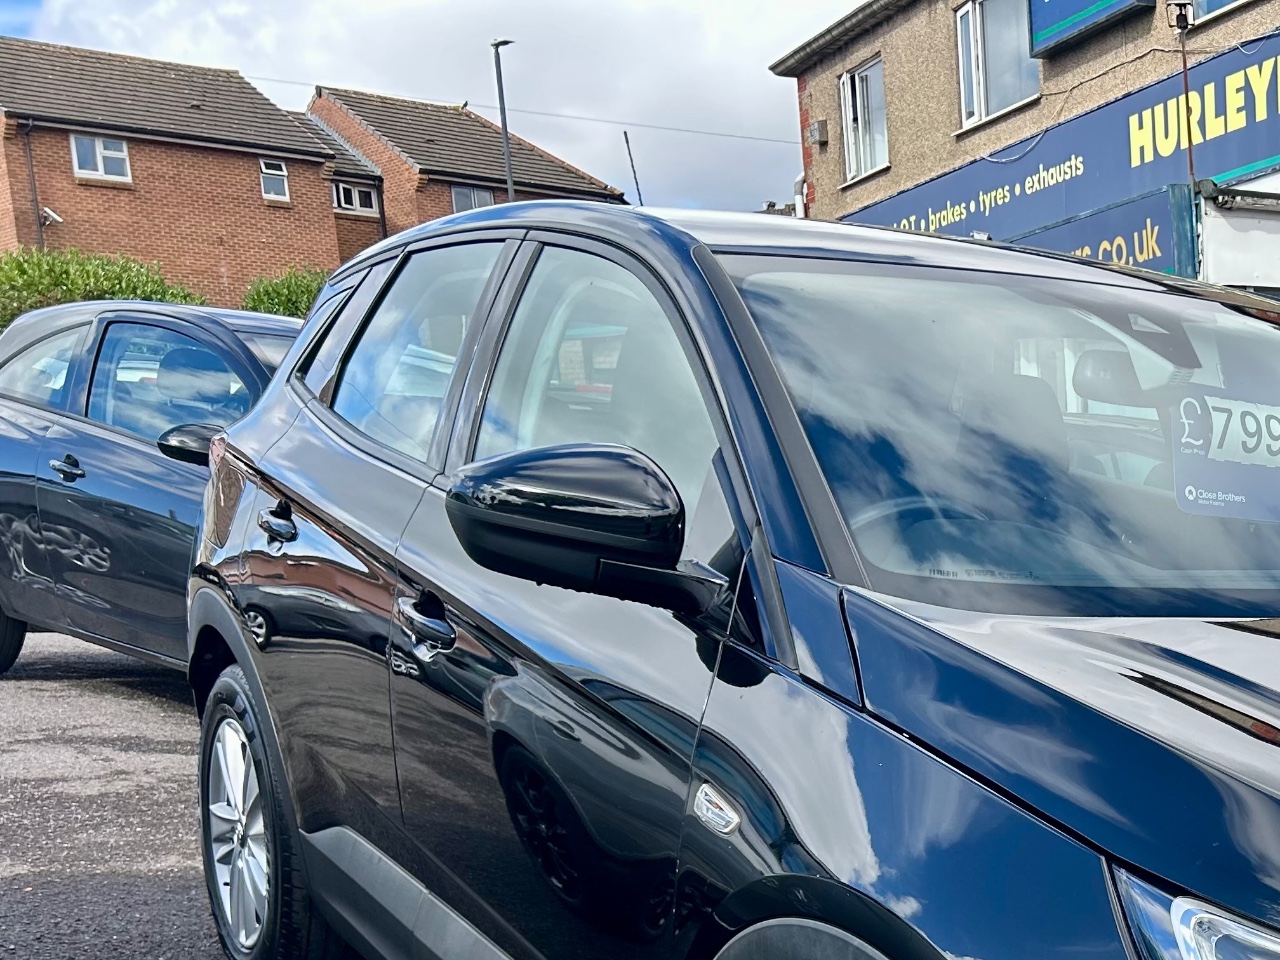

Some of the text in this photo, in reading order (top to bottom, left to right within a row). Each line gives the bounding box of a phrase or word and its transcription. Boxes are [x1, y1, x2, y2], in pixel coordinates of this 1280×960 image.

[928, 200, 967, 233] brakes
[979, 187, 1010, 217] tyres
[1024, 154, 1084, 195] exhausts
[1197, 489, 1246, 503] Close Brothers
